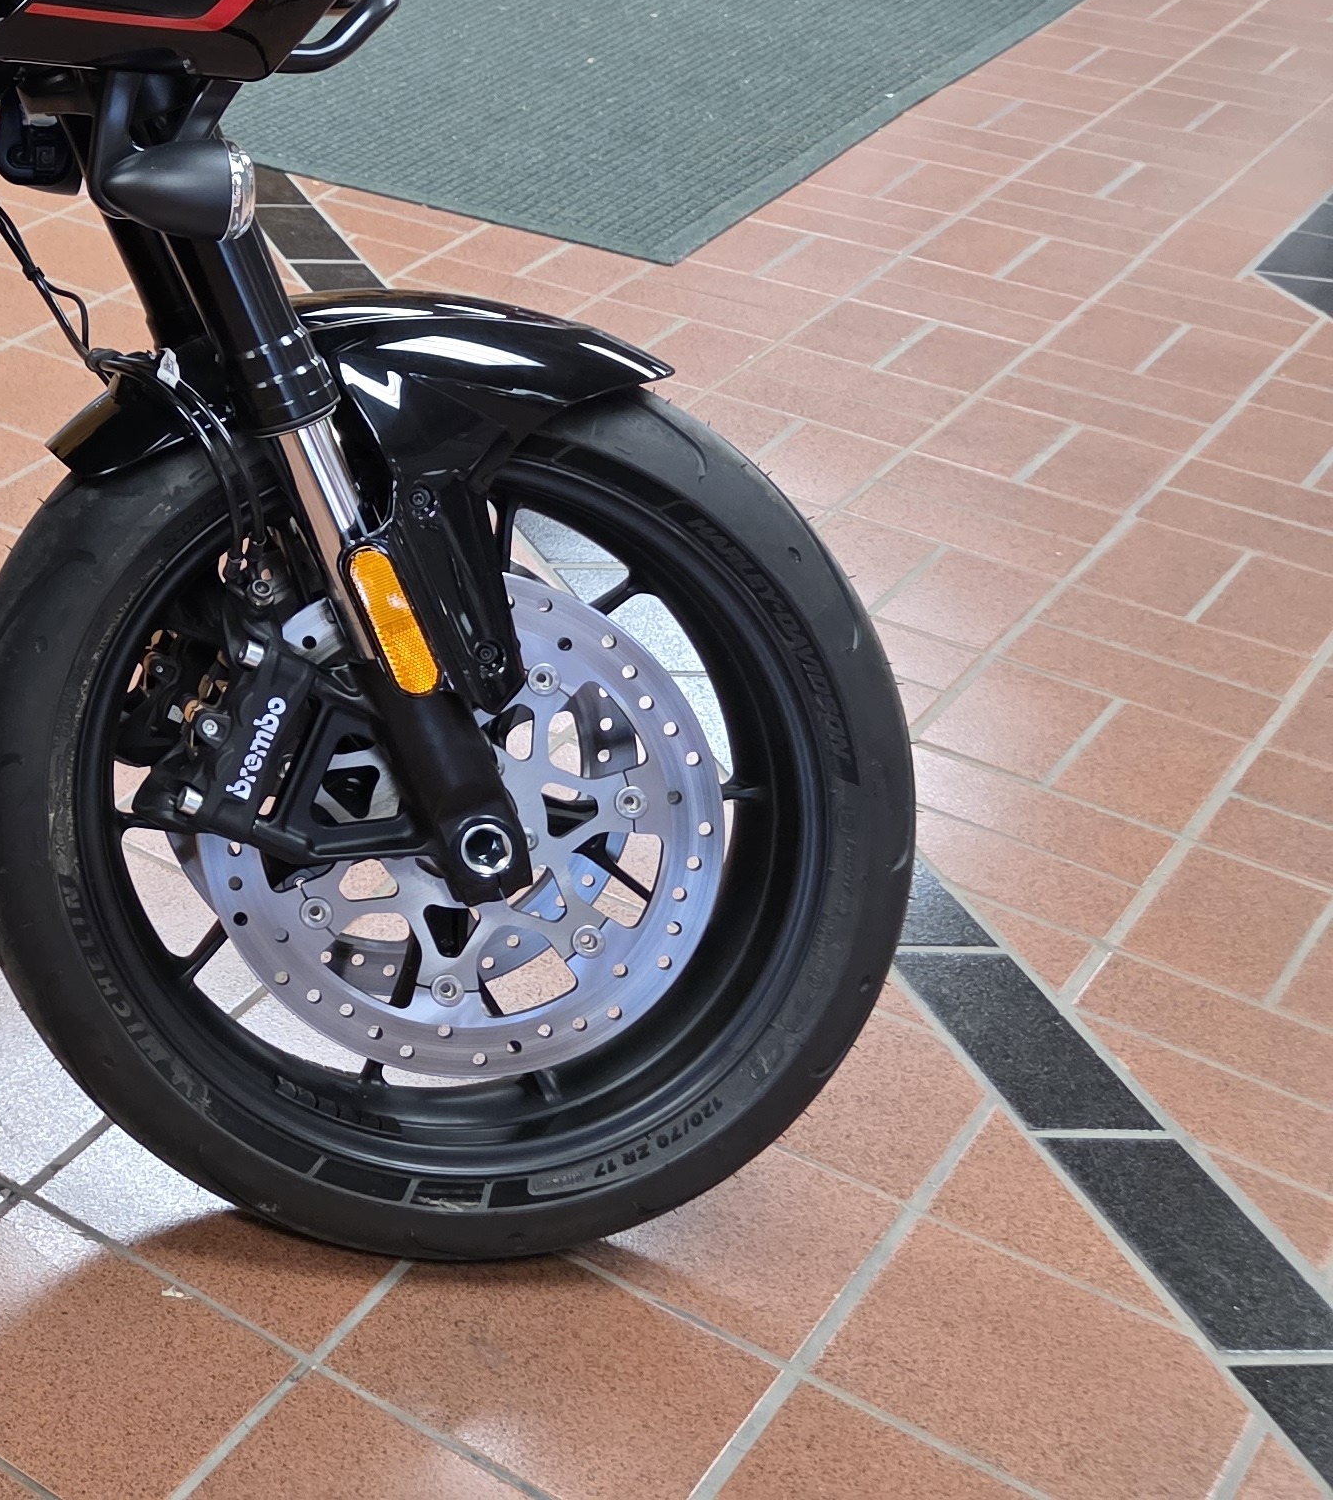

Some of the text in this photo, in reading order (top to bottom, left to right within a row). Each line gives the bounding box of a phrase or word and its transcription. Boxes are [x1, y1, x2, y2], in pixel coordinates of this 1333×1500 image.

[685, 516, 852, 764] HARLEY-DAVIDSON
[226, 697, 286, 800] brembo
[61, 883, 171, 1062] MICHELIN
[593, 1094, 725, 1180] 120/70 ZR 17
